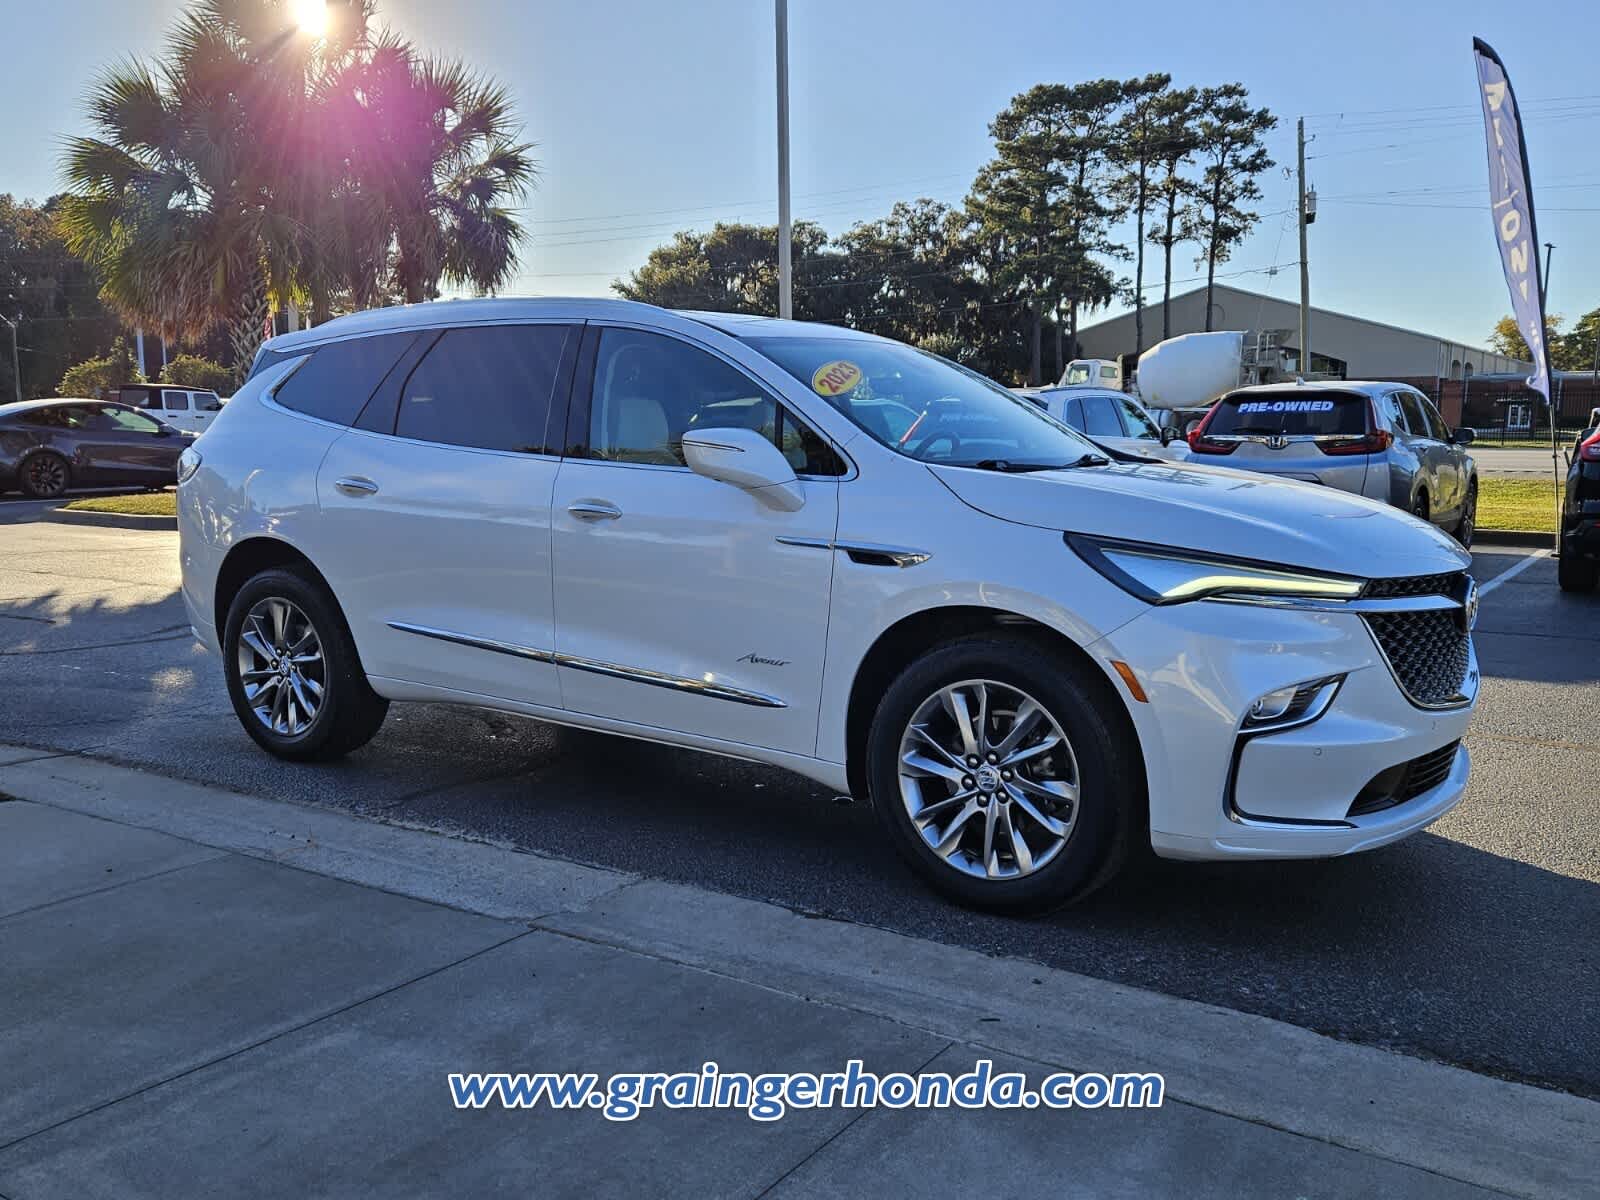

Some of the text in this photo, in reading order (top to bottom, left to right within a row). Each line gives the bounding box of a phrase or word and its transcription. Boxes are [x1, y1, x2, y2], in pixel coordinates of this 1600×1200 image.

[819, 362, 857, 393] 2023
[1238, 401, 1334, 413] PRE-OWNED
[736, 652, 792, 666] Avenir
